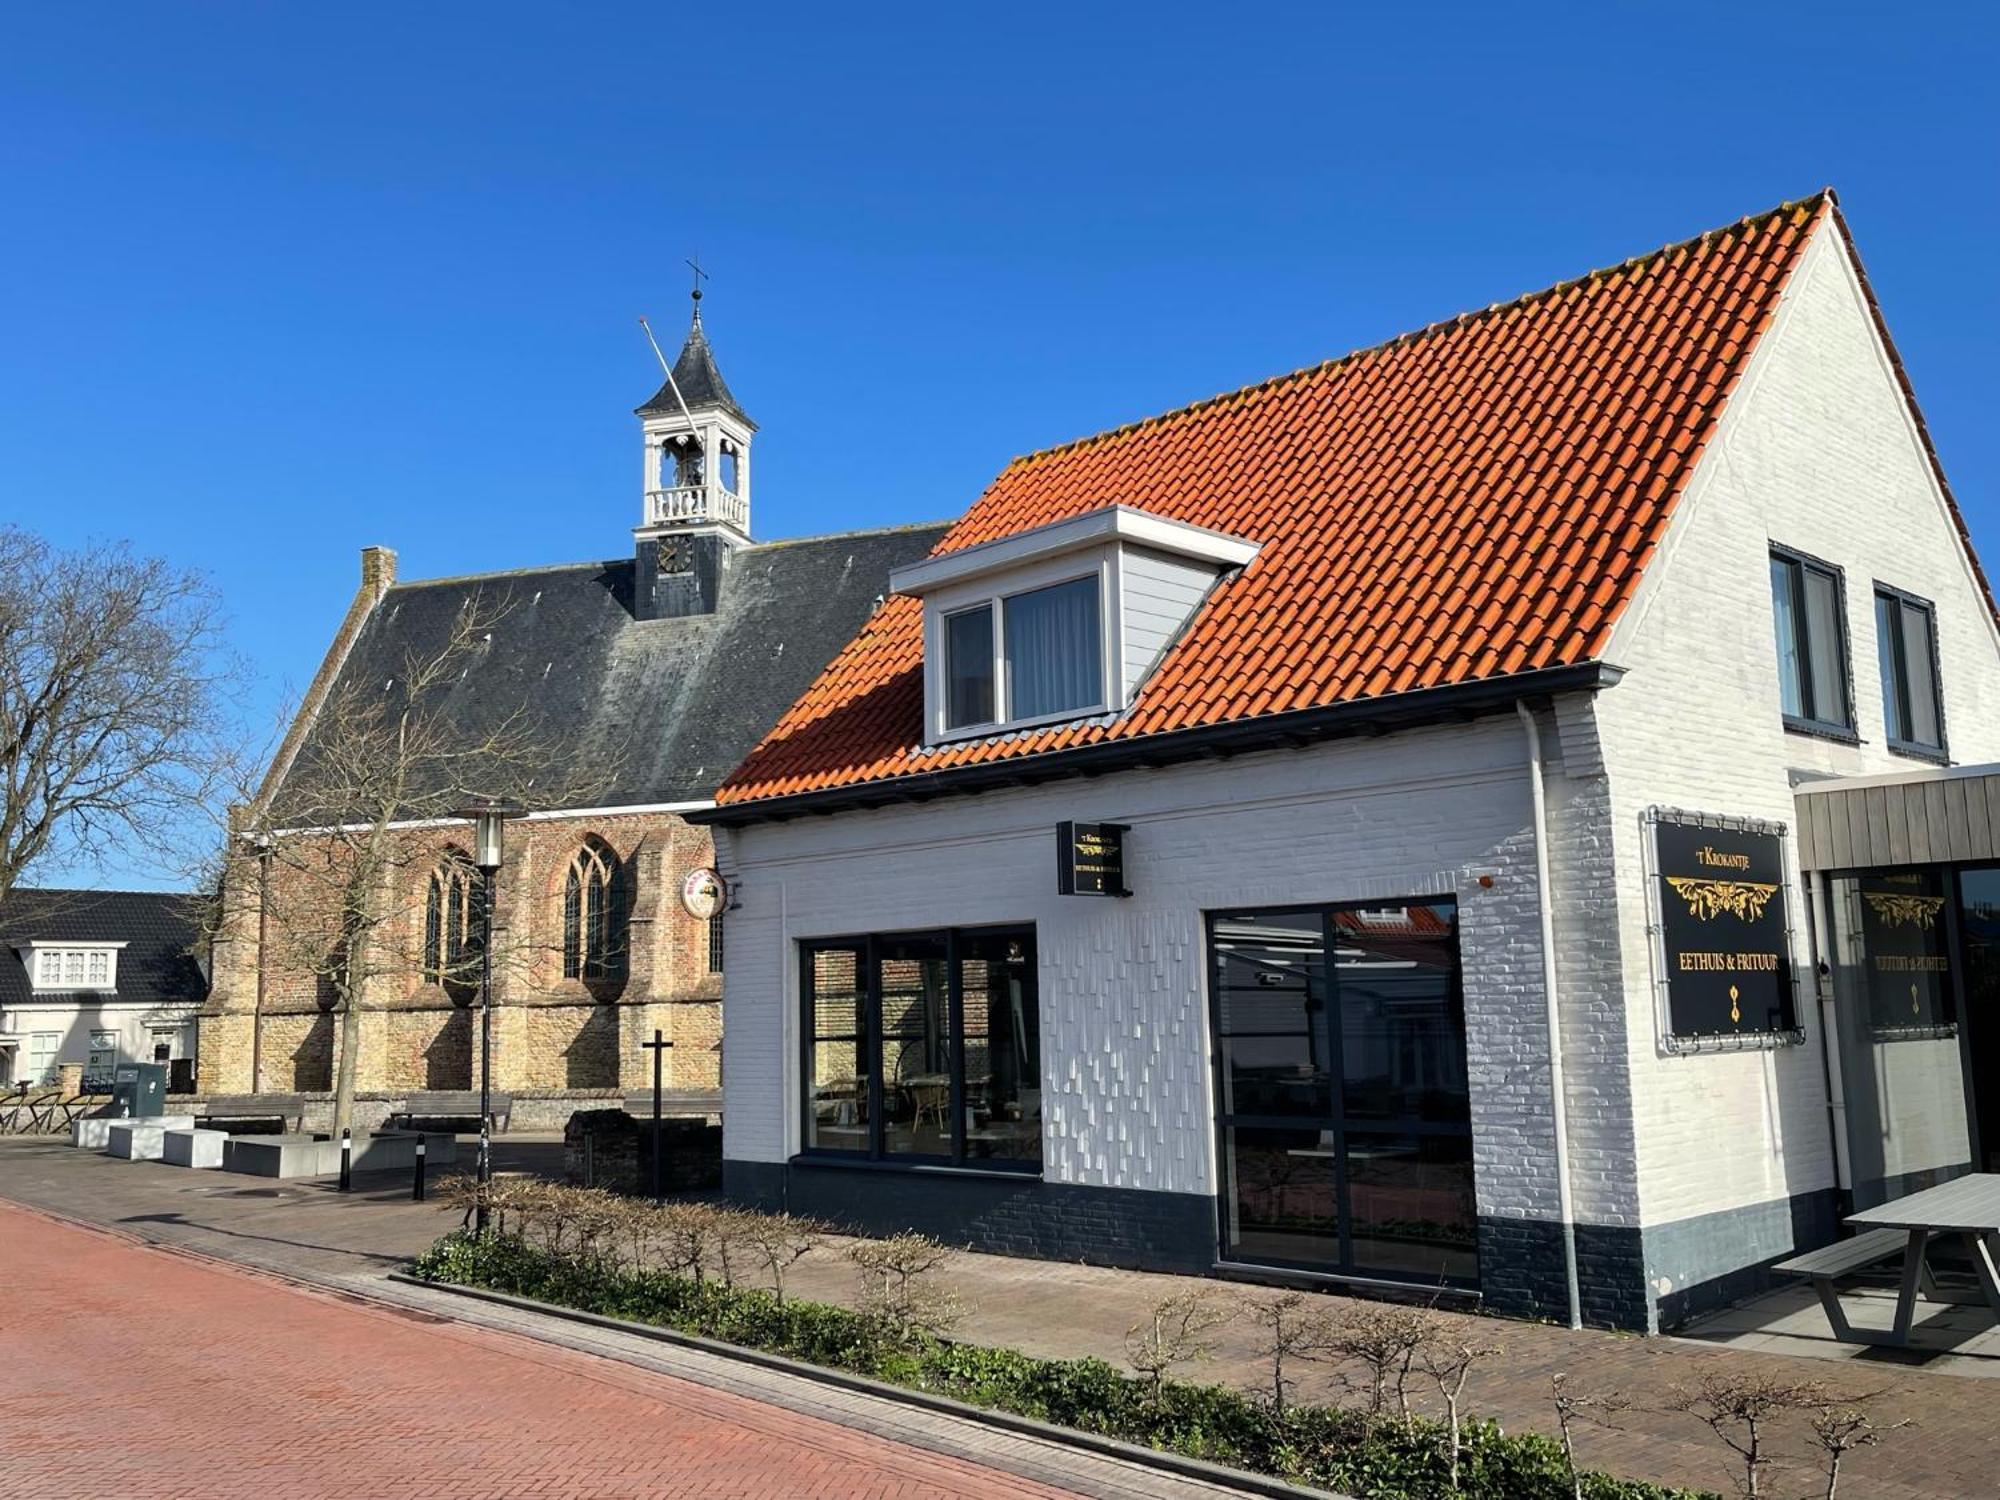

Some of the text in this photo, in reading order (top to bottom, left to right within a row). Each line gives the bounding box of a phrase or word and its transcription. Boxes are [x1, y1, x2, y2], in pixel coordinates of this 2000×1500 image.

[1680, 952, 1780, 970] EETHUIS & FRITUUR
